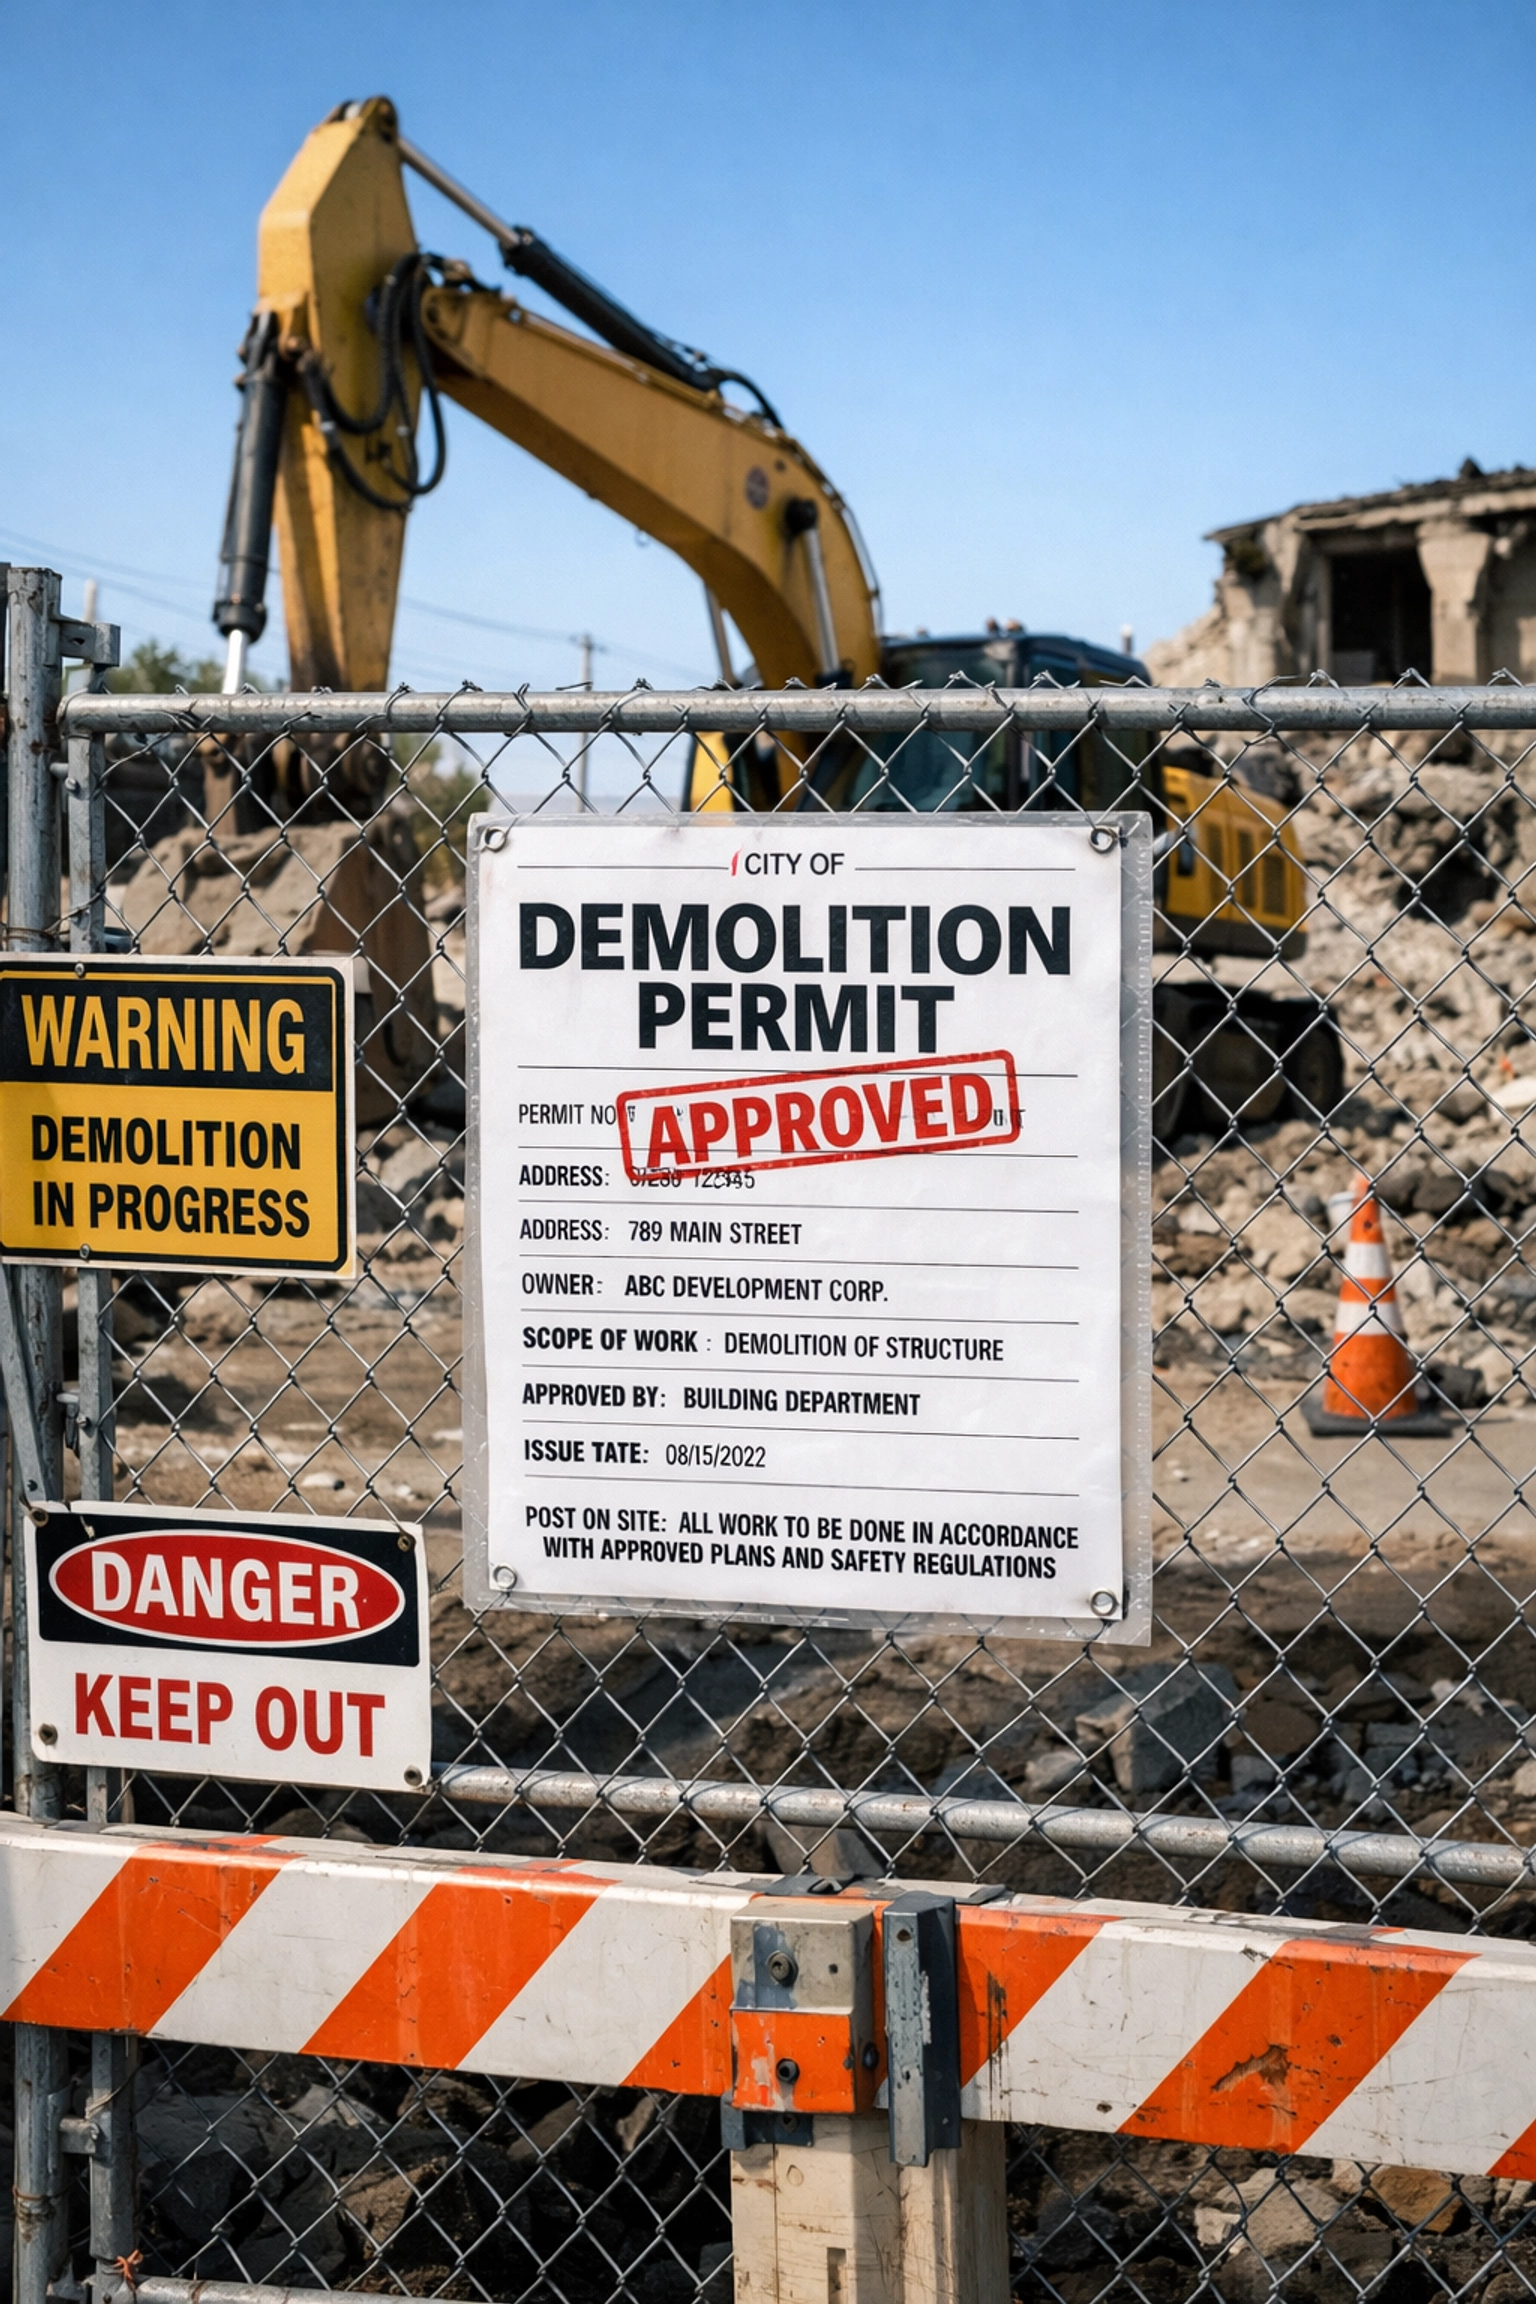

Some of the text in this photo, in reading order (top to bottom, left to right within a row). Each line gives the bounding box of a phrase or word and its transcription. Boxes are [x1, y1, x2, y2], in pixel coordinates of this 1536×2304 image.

[744, 852, 845, 876] CITY OF
[519, 902, 1071, 976] DEMOLITION
[21, 995, 305, 1075] WARNING
[637, 981, 956, 1055] PERMIT
[518, 1103, 585, 1125] PERMIT
[647, 1073, 993, 1168] APPROVED
[31, 1114, 302, 1171] DEMOLITION
[518, 1164, 610, 1187] ADDRESS:
[32, 1180, 311, 1239] IN PROGRESS
[519, 1218, 803, 1245] ADDRESS: 789 MAIN STREET
[521, 1272, 888, 1302] OWNER: ABC DEVELOPMENT CORP.
[522, 1326, 594, 1350] SCOPE
[600, 1327, 628, 1351] OF
[633, 1329, 698, 1353] WORK
[724, 1331, 847, 1357] DEMOLITION
[854, 1335, 880, 1358] OF
[886, 1336, 1004, 1361] STRUCTURE
[522, 1382, 921, 1416] APPROVED BY: BUILDING DEPARTMENT
[524, 1438, 766, 1468] ISSUE TATE: 08/15/2022
[525, 1505, 1079, 1550] POST ON SITE: ALL WORK TO BE DONE IN ACCORDANCE
[542, 1535, 1057, 1580] WITH APPROVED PLANS AND SAFETY REGULATIONS
[90, 1549, 362, 1630] DANGER
[75, 1672, 385, 1757] KEEP OUT
